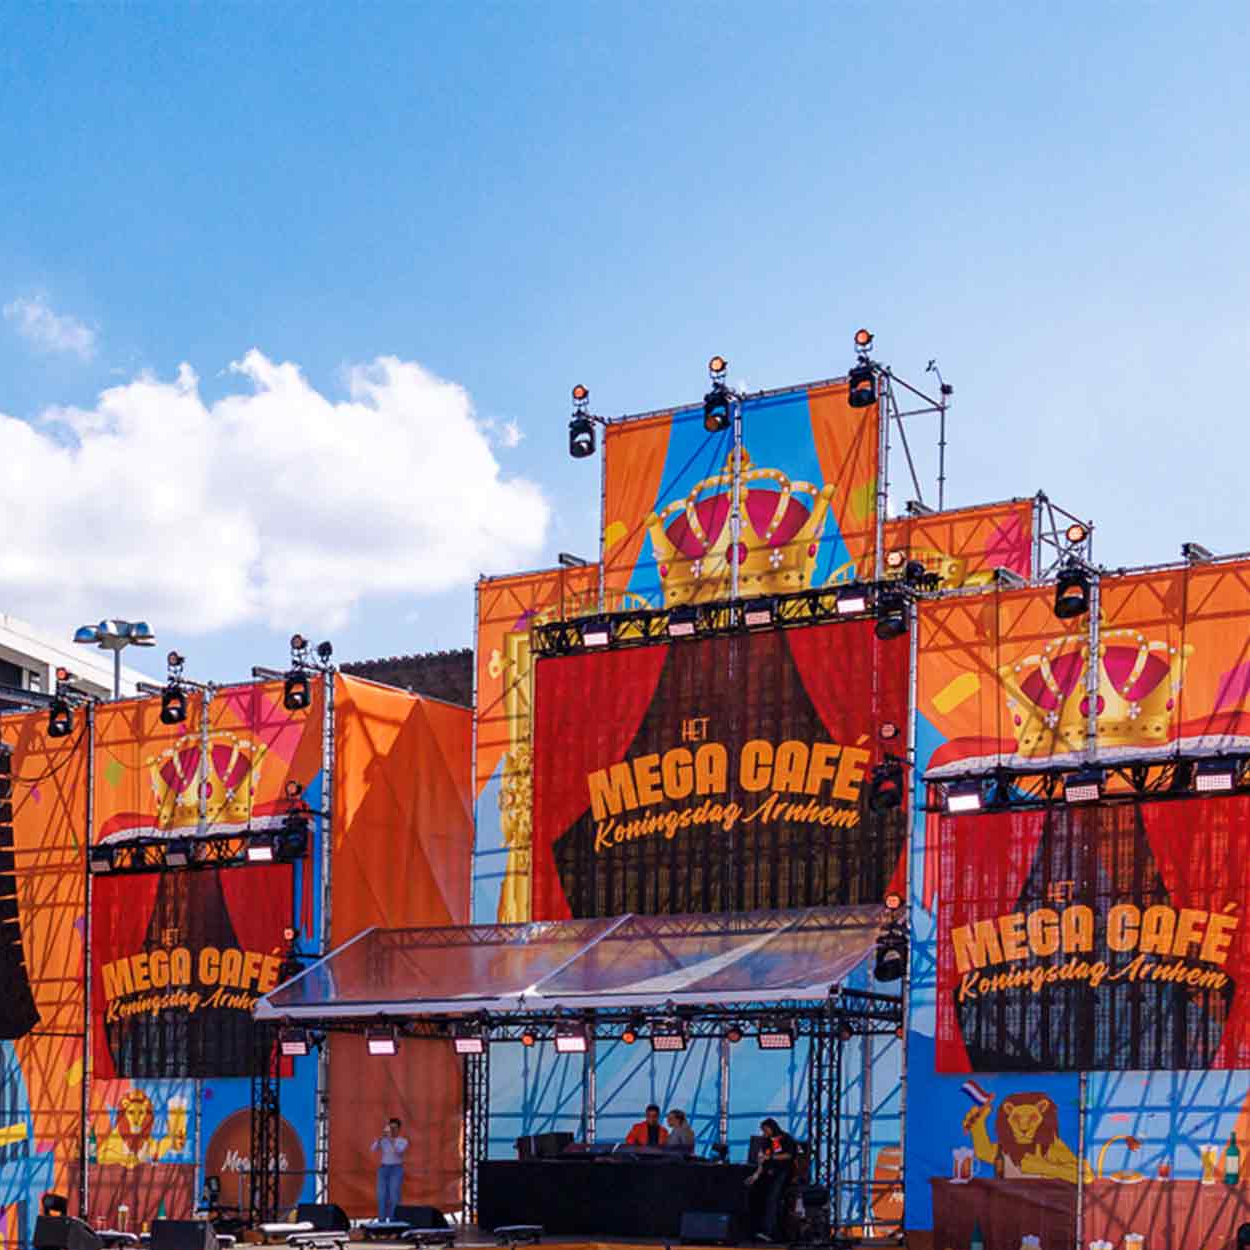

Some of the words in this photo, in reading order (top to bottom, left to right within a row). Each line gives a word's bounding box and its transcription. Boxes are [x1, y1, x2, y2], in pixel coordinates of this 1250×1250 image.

[682, 717, 710, 742] HET
[587, 741, 729, 822] MEGA
[739, 734, 871, 802] CAFÉ
[594, 799, 744, 852] Koningsdag
[741, 792, 861, 830] Arnhem
[951, 904, 1095, 975] MEGA
[1106, 902, 1239, 965] CAFÉ
[101, 947, 192, 1001] MEGA
[199, 946, 284, 994] CAFÉ
[958, 957, 1110, 1002] Koningsdag
[1107, 953, 1229, 990] Arnhem
[106, 991, 200, 1024] Koningsdag
[200, 986, 259, 1009] Arnhe
